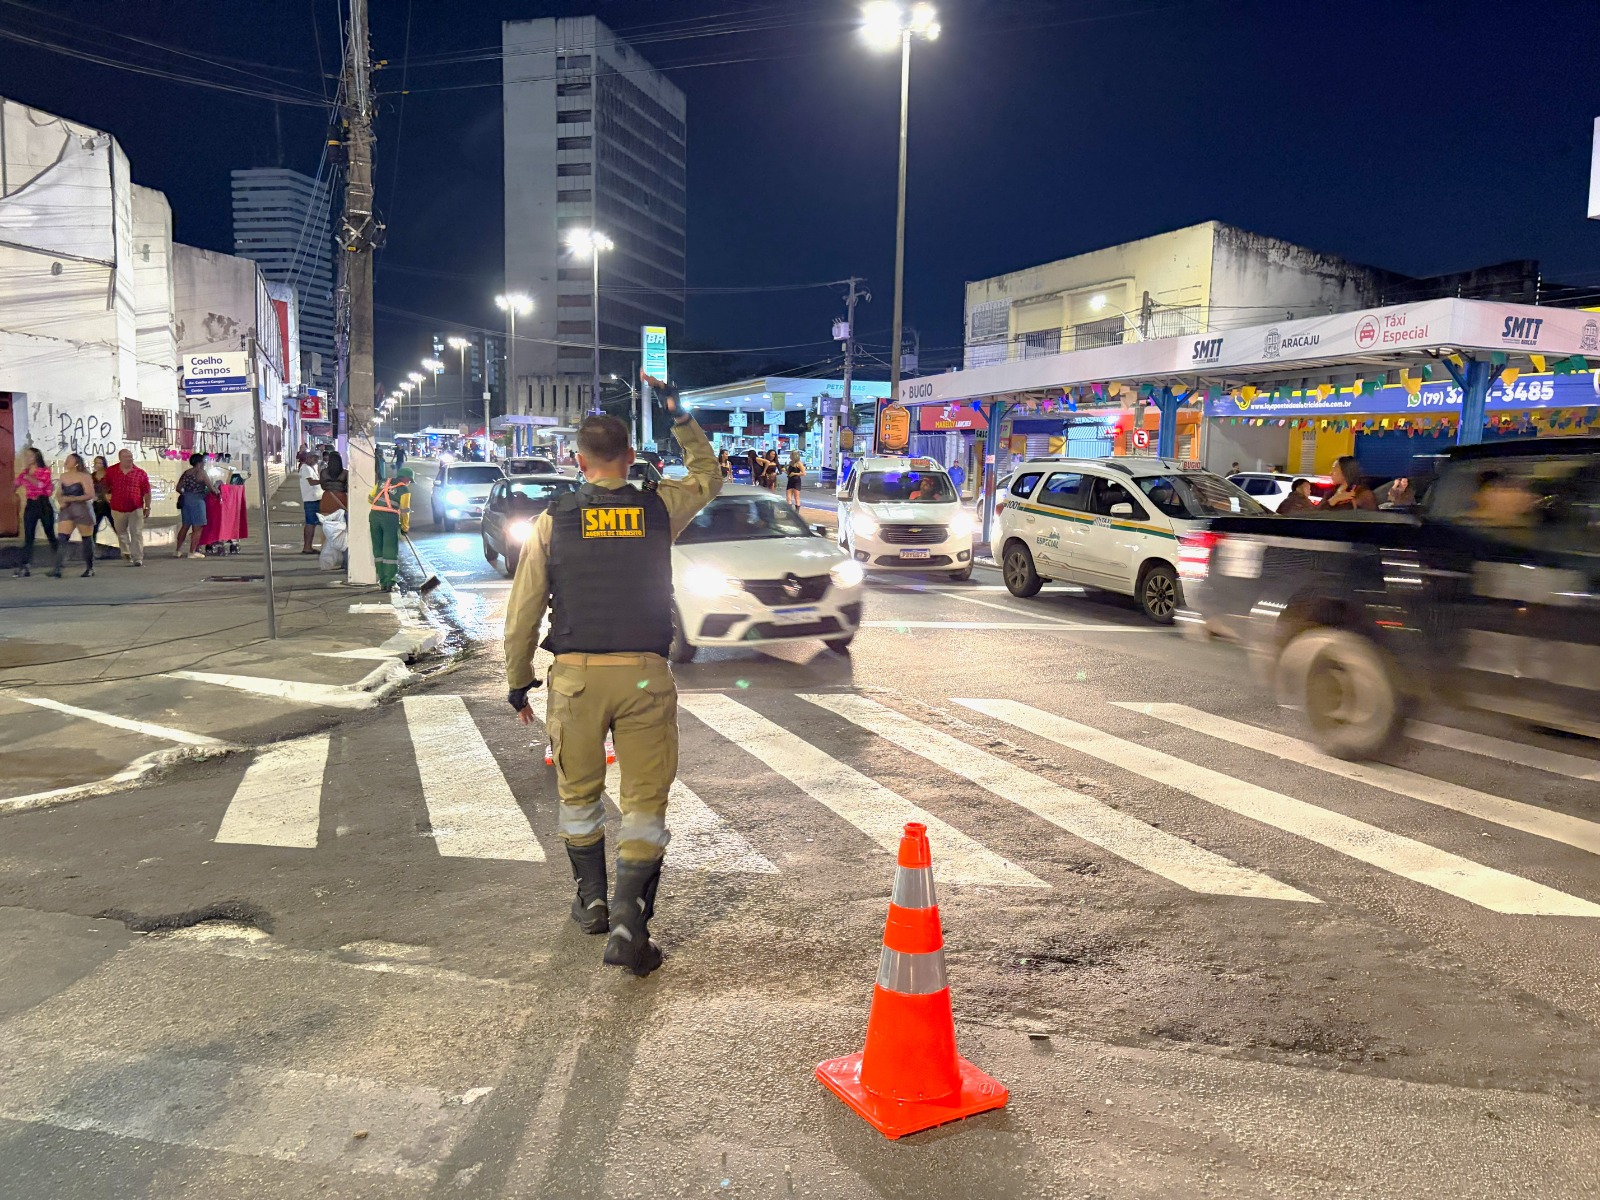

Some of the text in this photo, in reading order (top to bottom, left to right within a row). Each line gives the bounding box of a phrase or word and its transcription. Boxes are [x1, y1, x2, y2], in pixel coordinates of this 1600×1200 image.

[1384, 313, 1406, 328] Táxi
[1501, 315, 1544, 340] SMTT
[646, 335, 665, 344] BR
[1281, 334, 1320, 349] ARACAJU
[1382, 325, 1429, 344] Especial
[1191, 337, 1224, 360] SMTT
[190, 356, 223, 366] Coelho
[191, 367, 231, 376] Campos
[826, 383, 866, 391] PETRRAS
[908, 383, 933, 398] BUGIO
[1422, 391, 1444, 406] (79)
[1183, 461, 1201, 469] BUGIO
[585, 509, 641, 531] SMTT
[1036, 536, 1059, 549] ESPECIAL
